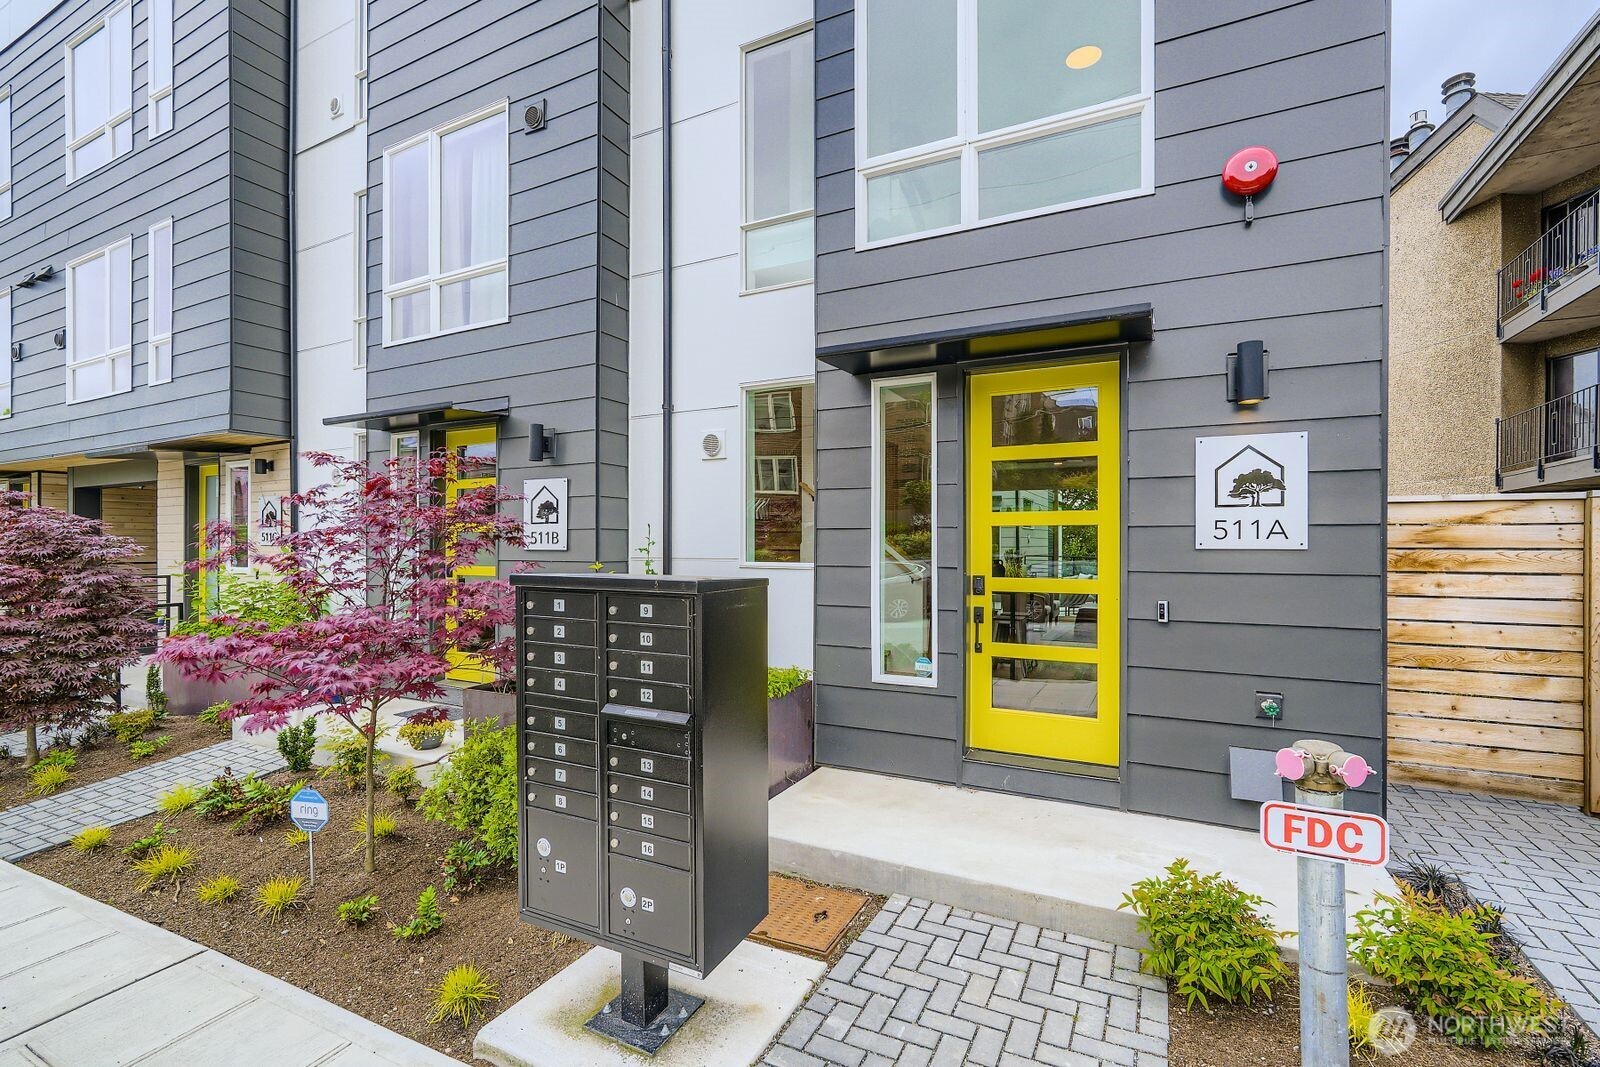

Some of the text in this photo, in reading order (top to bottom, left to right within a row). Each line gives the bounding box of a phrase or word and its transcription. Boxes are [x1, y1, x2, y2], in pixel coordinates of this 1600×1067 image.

[1213, 519, 1289, 540] 511A
[530, 531, 559, 545] 511B
[556, 601, 561, 610] 1
[643, 606, 649, 616] 9
[556, 627, 562, 636] 2
[641, 634, 652, 644] 10
[557, 653, 562, 663] 3
[641, 662, 651, 672] 11
[557, 680, 562, 688] 4
[642, 690, 652, 701] 12
[557, 719, 563, 728] 5
[557, 745, 563, 754] 6
[642, 761, 652, 771] 13
[558, 771, 563, 779] 7
[642, 788, 652, 799] 14
[558, 797, 563, 806] 8
[299, 804, 319, 817] ring
[643, 816, 653, 826] 15
[1284, 813, 1363, 854] FDC
[643, 844, 653, 854] 16
[556, 862, 565, 871] 1P
[642, 899, 653, 909] 2P
